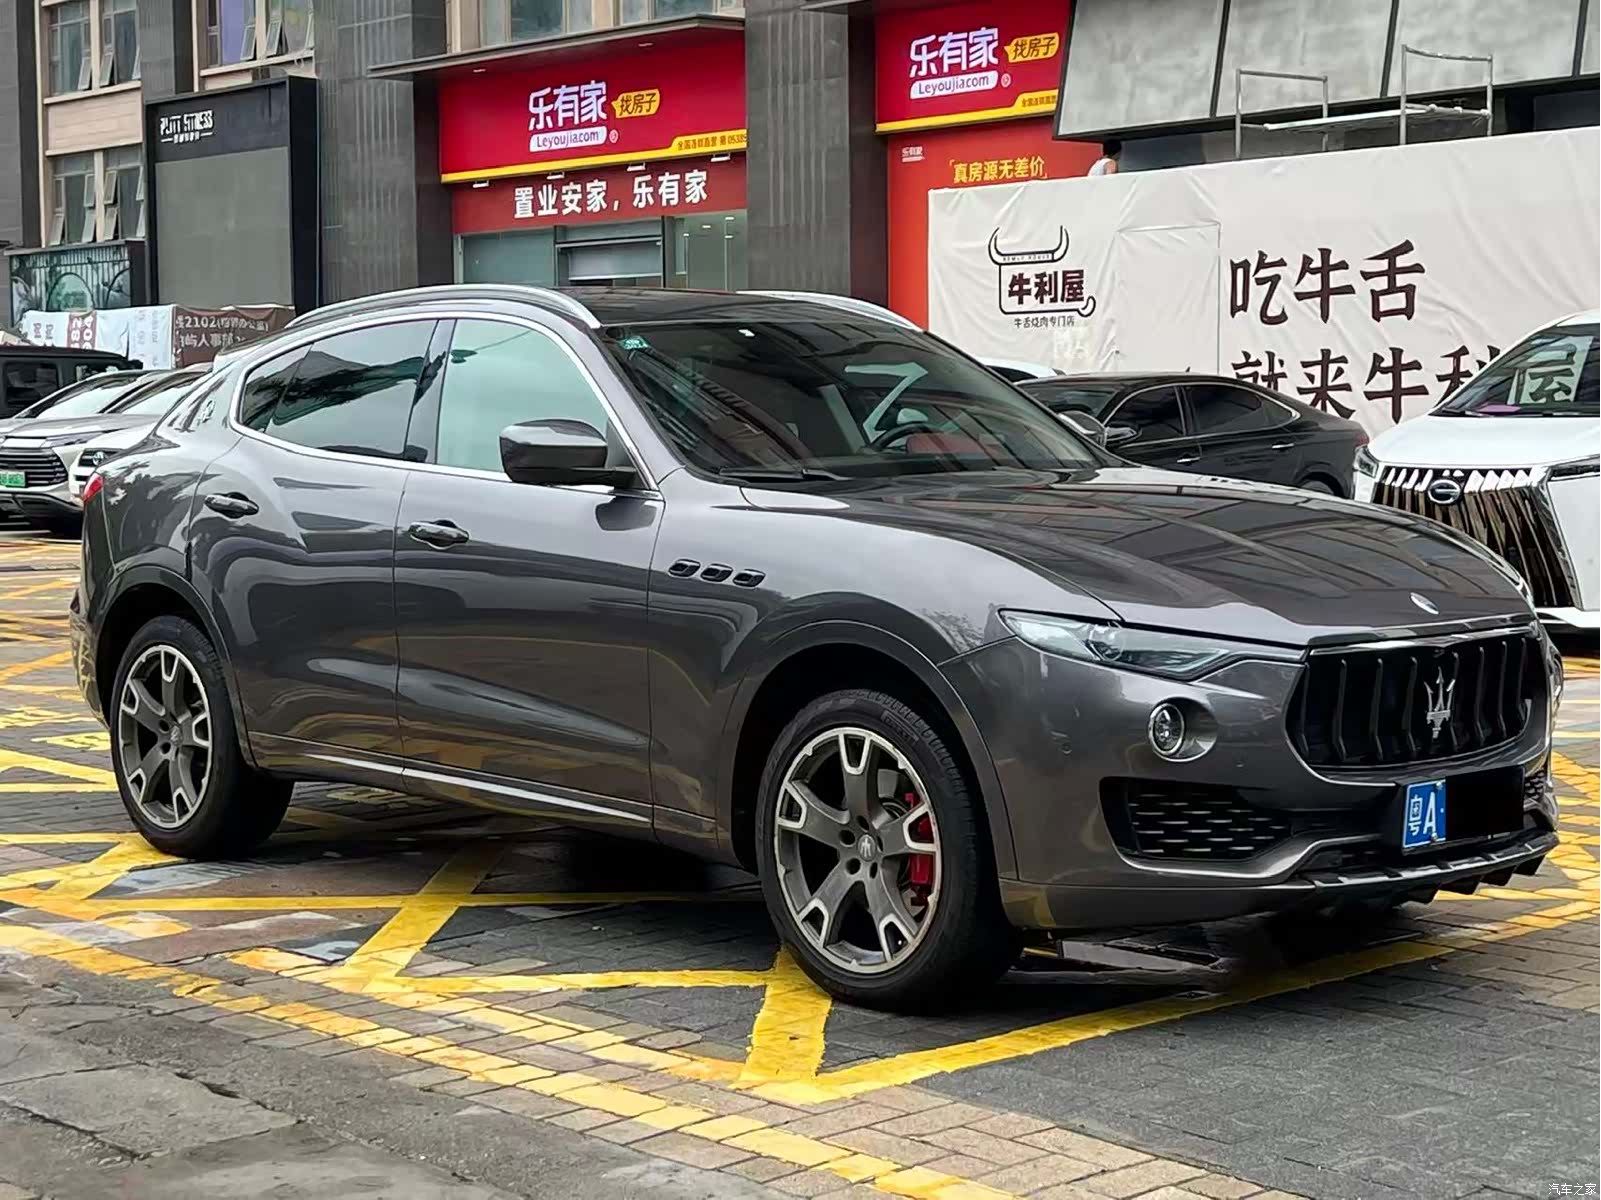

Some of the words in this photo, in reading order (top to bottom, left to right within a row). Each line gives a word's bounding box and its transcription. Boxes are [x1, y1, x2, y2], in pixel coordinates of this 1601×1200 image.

[909, 27, 999, 78] 乐有家
[1012, 36, 1056, 60] 找房子
[528, 80, 607, 131] 乐有家
[619, 93, 657, 116] 找房子
[1007, 269, 1085, 305] 牛利屋
[1229, 239, 1426, 325] 吃牛舌
[1013, 315, 1076, 329] 牛舌烧肉专门店
